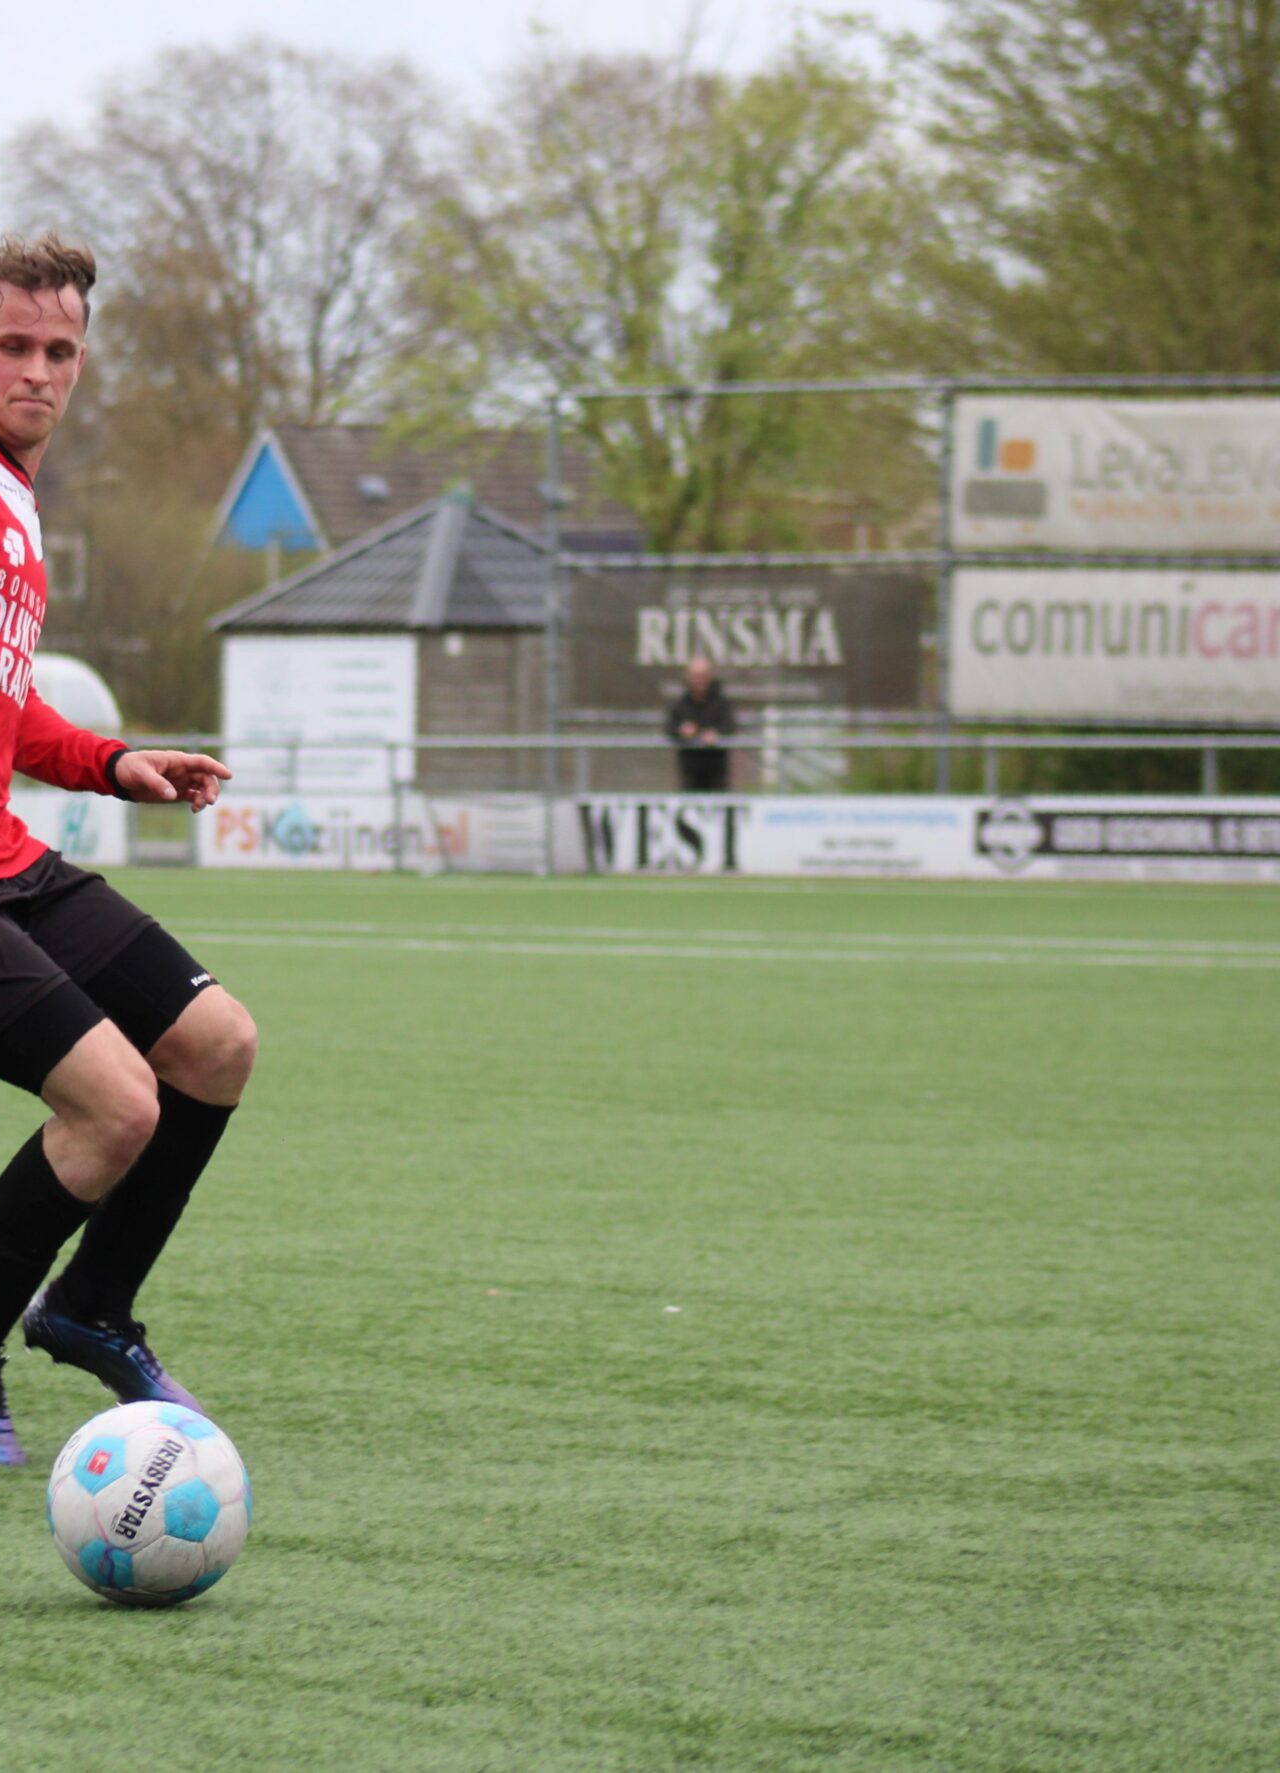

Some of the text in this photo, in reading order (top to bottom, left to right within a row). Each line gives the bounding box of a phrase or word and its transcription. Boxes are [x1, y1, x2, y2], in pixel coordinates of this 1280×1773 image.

[637, 606, 844, 666] RINSMA
[578, 803, 751, 866] WEST
[115, 1439, 184, 1540] DERBYSTAR
